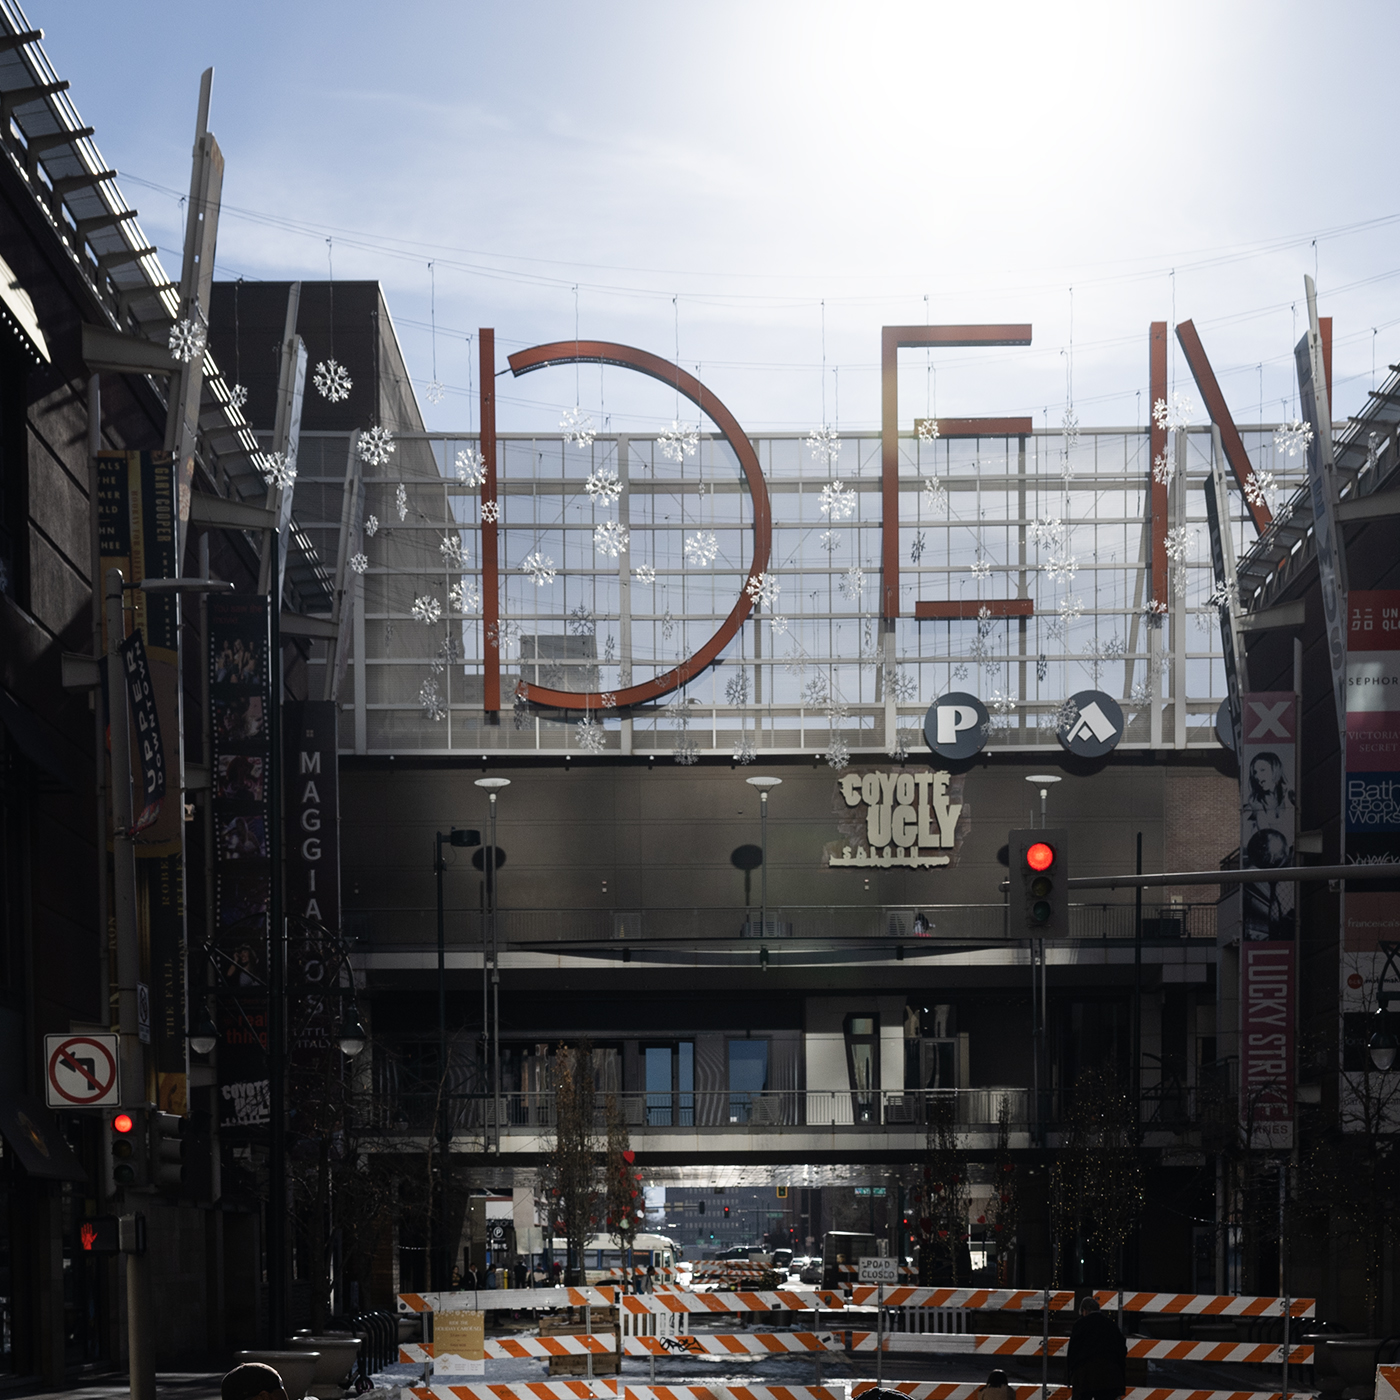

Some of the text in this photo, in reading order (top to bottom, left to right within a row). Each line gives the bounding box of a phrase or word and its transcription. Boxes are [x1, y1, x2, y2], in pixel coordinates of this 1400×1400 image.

[100, 460, 121, 471] ALS
[98, 490, 121, 500] MER
[98, 505, 119, 514] RLD
[154, 466, 172, 542] GARY COOPER
[98, 526, 115, 535] HN
[100, 541, 121, 550] HEE
[135, 641, 165, 785] DOWNTOWN
[125, 647, 157, 793] UPPER
[1358, 742, 1399, 753] SECRET
[838, 770, 951, 807] COYOTE
[866, 803, 963, 848] UGLY
[842, 845, 920, 861] SALOON
[1247, 948, 1290, 1117] LUCKY STRIKE
[1254, 1124, 1288, 1135] ANES
